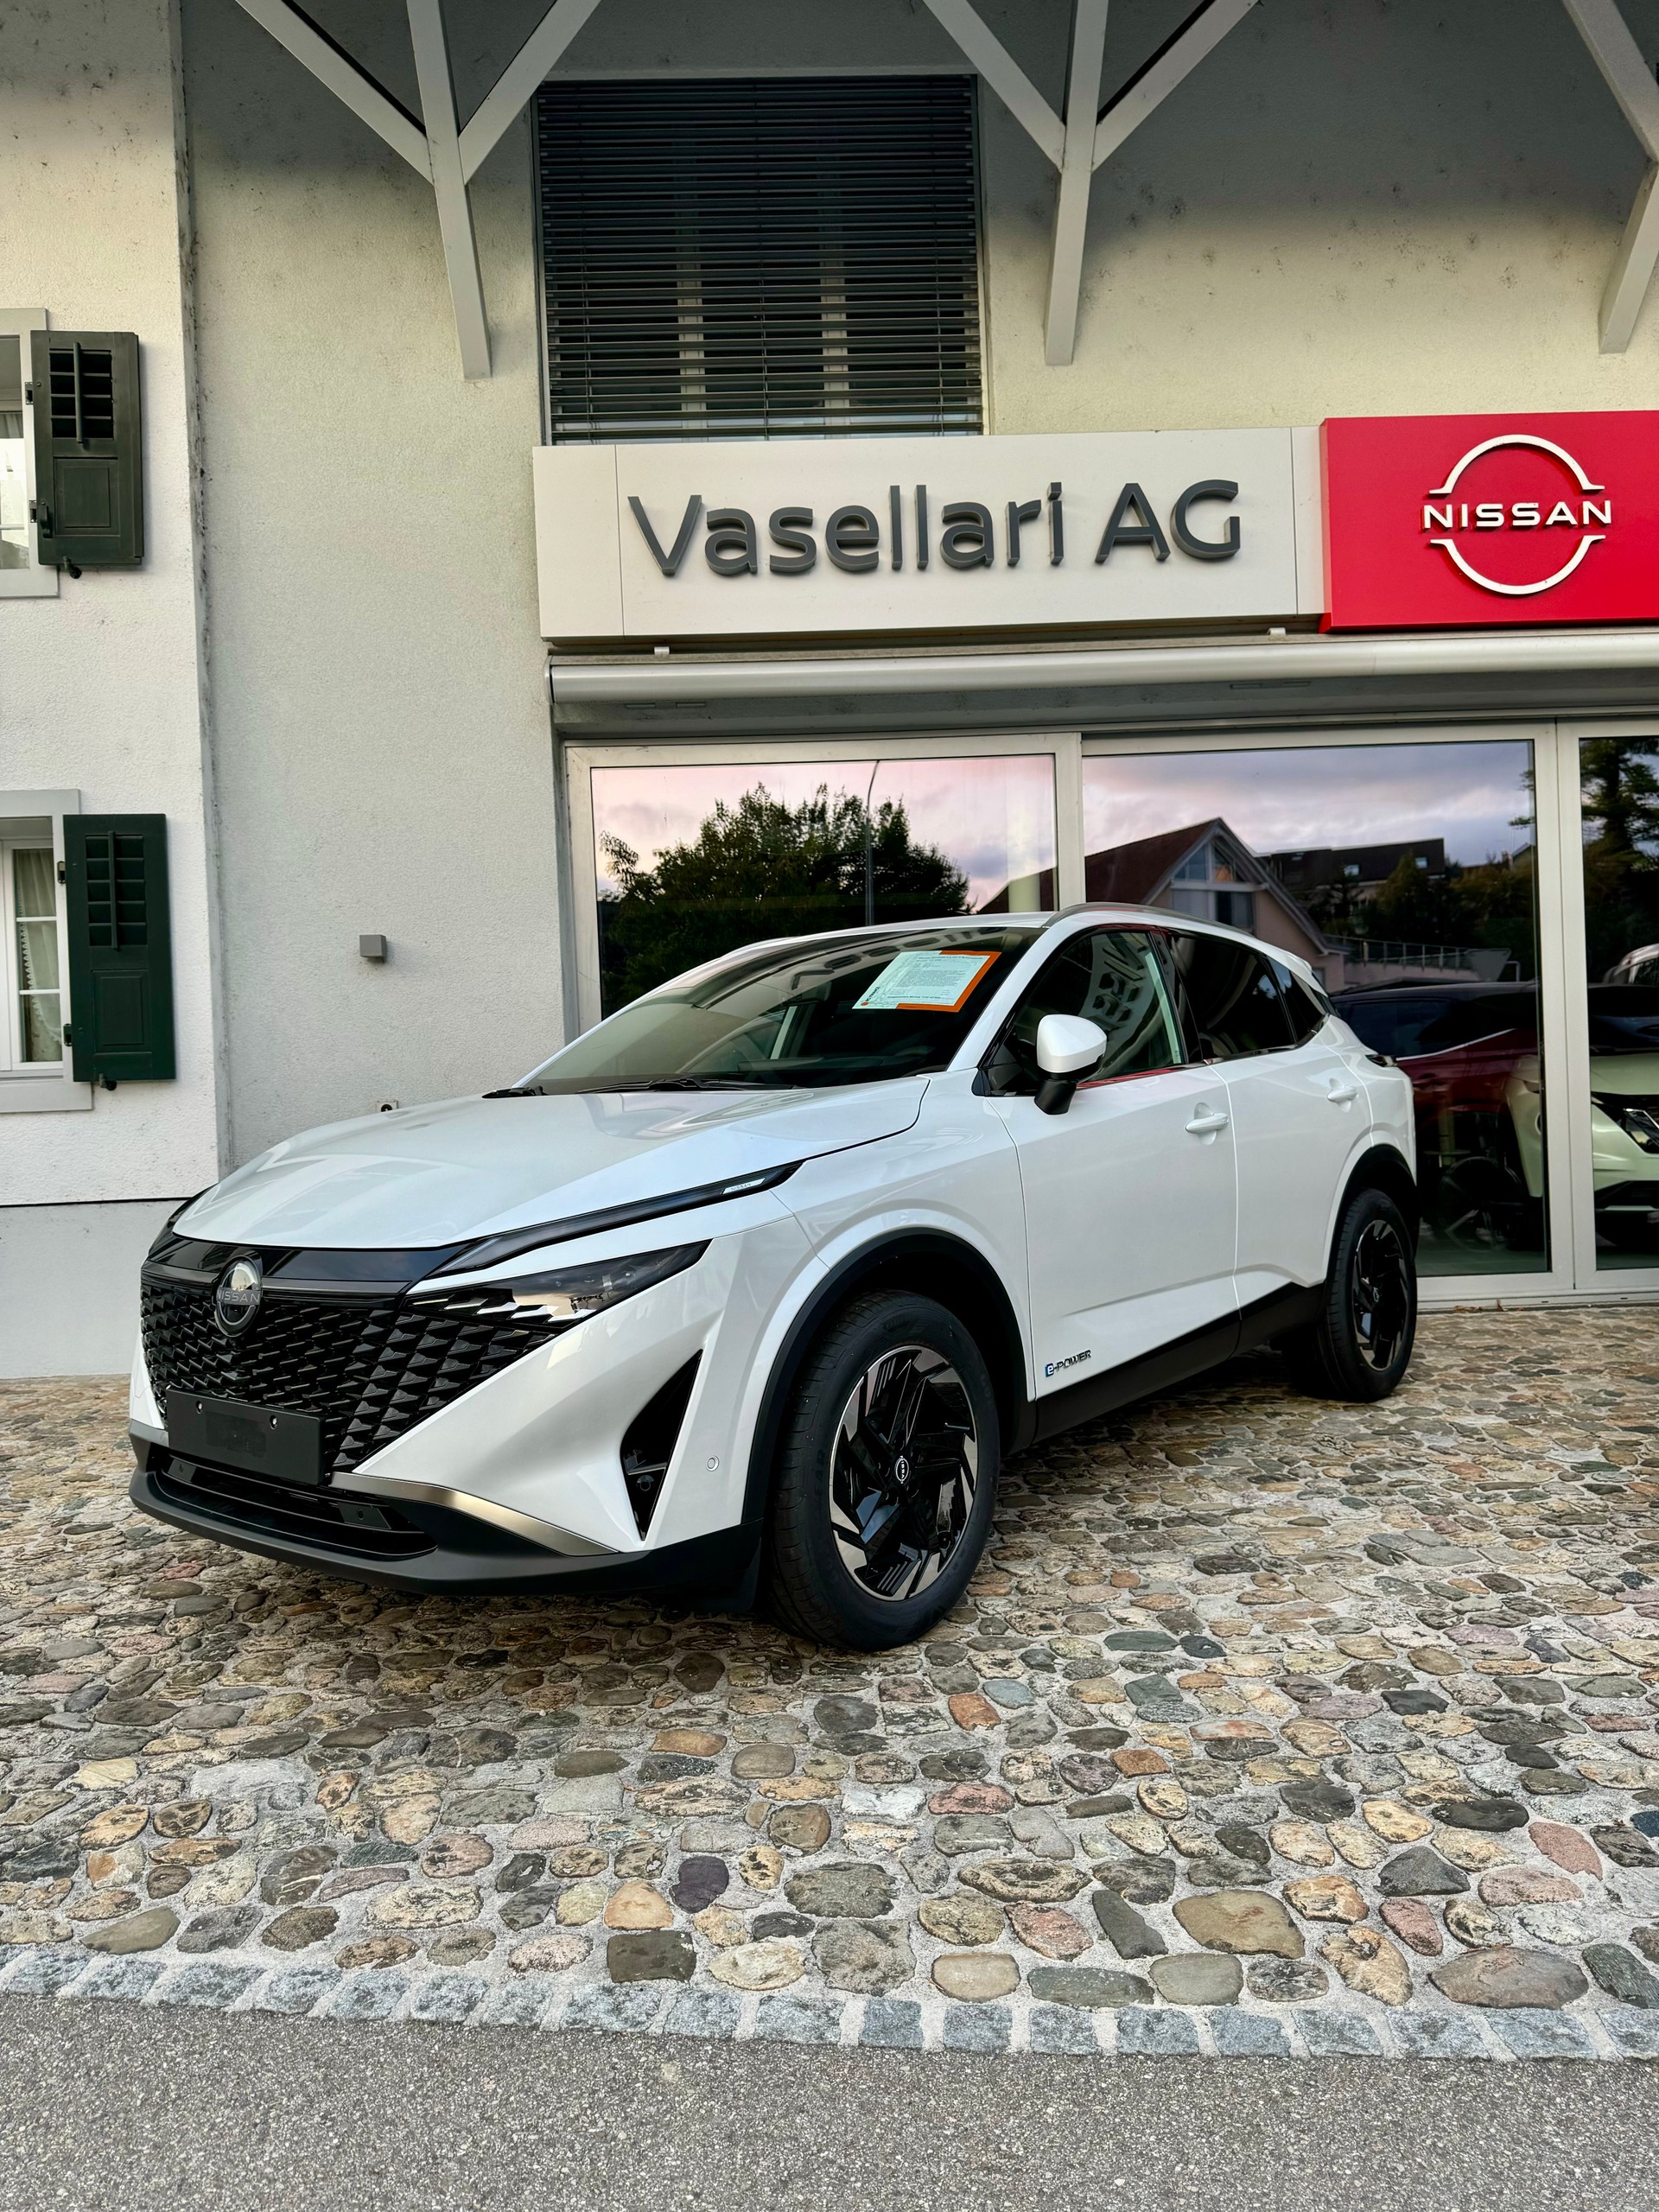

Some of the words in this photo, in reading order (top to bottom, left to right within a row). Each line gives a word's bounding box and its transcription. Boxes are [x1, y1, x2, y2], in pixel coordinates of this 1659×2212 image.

[627, 481, 1064, 577] Vasellari
[1094, 479, 1241, 564] AG
[1423, 499, 1611, 529] NISSAN
[216, 1290, 260, 1303] NISSAN
